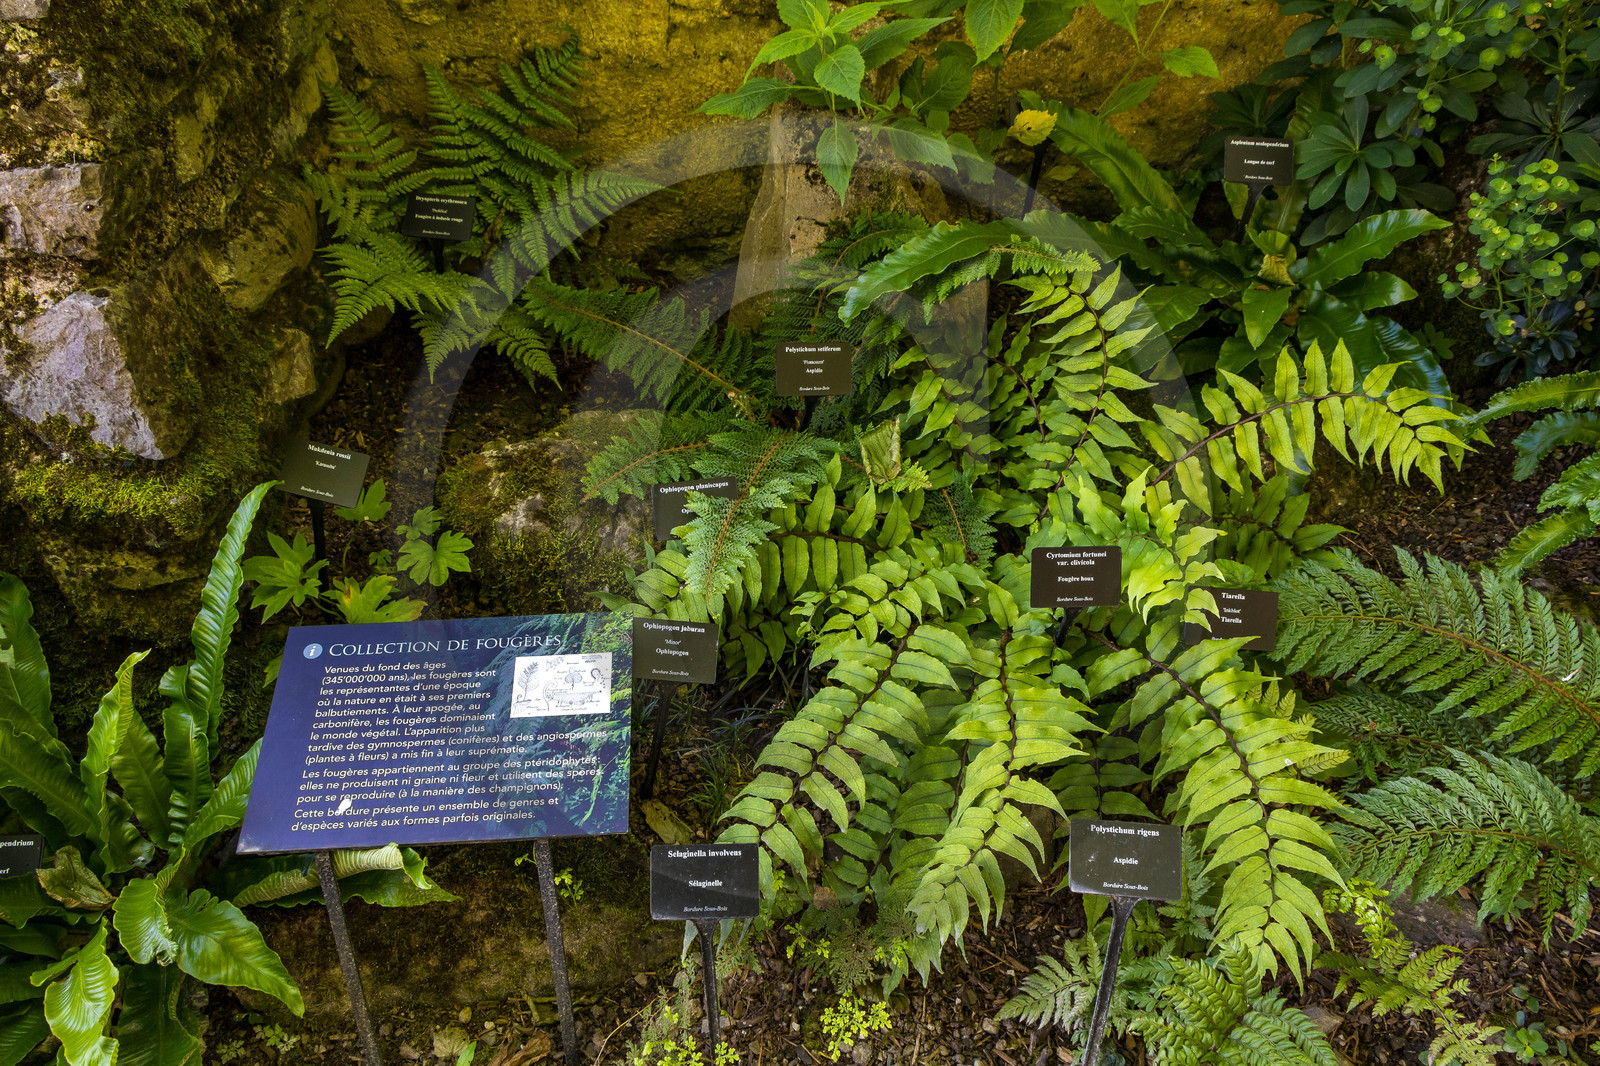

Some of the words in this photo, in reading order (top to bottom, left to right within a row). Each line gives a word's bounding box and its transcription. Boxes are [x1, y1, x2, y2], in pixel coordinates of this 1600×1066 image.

[785, 346, 816, 354] Polystichum
[308, 444, 335, 456] Mukdenia
[336, 452, 352, 460] rossii
[660, 486, 695, 494] Ophiopogon
[696, 482, 729, 490] planiscapus
[1046, 551, 1081, 560] Cyrtomium
[1221, 592, 1246, 600] Tiarella
[643, 622, 680, 632] Ophiopogon
[680, 625, 705, 633] jaburan
[1220, 616, 1242, 624] Tiarella
[329, 640, 440, 657] COLLECTION
[447, 639, 469, 651] DE
[476, 634, 562, 650] FOUGÈRES
[655, 648, 689, 657] Ophiopogon
[324, 666, 360, 674] Venues
[362, 664, 375, 672] du
[378, 662, 400, 672] fond
[403, 661, 420, 670] des
[423, 660, 446, 671] âges
[388, 674, 410, 682] ans),
[412, 672, 427, 680] les
[428, 670, 473, 681] fougères
[474, 670, 496, 678] sont
[320, 687, 334, 696] les
[336, 684, 410, 696] représentantes
[443, 680, 481, 692] époque
[317, 698, 330, 707] où
[332, 698, 342, 706] la
[344, 696, 376, 705] nature
[394, 693, 417, 702] était
[420, 692, 426, 702] à
[446, 691, 491, 700] premiers
[314, 706, 390, 718] balbutiements.
[392, 704, 400, 714] À
[402, 704, 422, 713] leur
[424, 702, 465, 716] apogée,
[312, 718, 373, 730] carbonifère,
[375, 718, 390, 726] les
[392, 715, 437, 728] fougères
[440, 712, 496, 723] dominaient
[310, 732, 320, 741] le
[322, 731, 358, 740] monde
[361, 728, 400, 742] végétal.
[464, 724, 486, 734] plus
[307, 743, 344, 752] tardive
[346, 742, 365, 750] des
[367, 738, 446, 751] gymnospermes
[448, 735, 500, 746] (conifères)
[516, 733, 534, 742] des
[536, 730, 608, 742] angiospermes
[304, 754, 346, 766] (plantes
[348, 752, 355, 762] à
[358, 751, 390, 762] fleurs)
[391, 752, 398, 760] a
[400, 750, 418, 759] mis
[421, 749, 434, 758] fin
[436, 748, 443, 757] à
[446, 747, 465, 756] leur
[468, 745, 528, 757] suprématie.
[302, 770, 320, 779] Les
[322, 767, 368, 780] fougères
[371, 764, 445, 777] appartiennent
[447, 764, 460, 772] au
[462, 762, 500, 773] groupe
[503, 760, 522, 768] des
[299, 782, 324, 791] elles
[341, 777, 398, 791] produisent
[401, 776, 412, 785] ni
[413, 776, 447, 787] graine
[449, 774, 459, 783] ni
[461, 772, 485, 782] fleur
[488, 772, 499, 780] et
[502, 770, 542, 780] utilisent
[545, 769, 564, 778] des
[296, 794, 322, 806] pour
[324, 794, 337, 802] se
[339, 790, 396, 802] reproduire
[398, 789, 408, 800] (à
[410, 788, 420, 798] la
[422, 786, 464, 797] manière
[467, 786, 486, 795] des
[294, 808, 324, 819] Cette
[372, 804, 420, 817] présente
[422, 804, 436, 812] un
[438, 800, 490, 811] ensemble
[492, 799, 506, 808] de
[509, 798, 545, 809] genres
[548, 797, 559, 806] et
[347, 818, 378, 828] variés
[380, 819, 400, 827] aux
[402, 815, 440, 826] formes
[442, 812, 480, 826] parfois
[482, 810, 536, 822] originales.
[1090, 824, 1135, 835] Polystichum
[1137, 828, 1160, 838] rigens
[668, 850, 706, 859] Selaginella
[708, 849, 742, 857] involvens
[1113, 856, 1138, 866] Aspidie
[688, 880, 723, 888] Sélaginelle
[1102, 881, 1123, 889] Bordure
[1123, 883, 1149, 891] Sous-Bois
